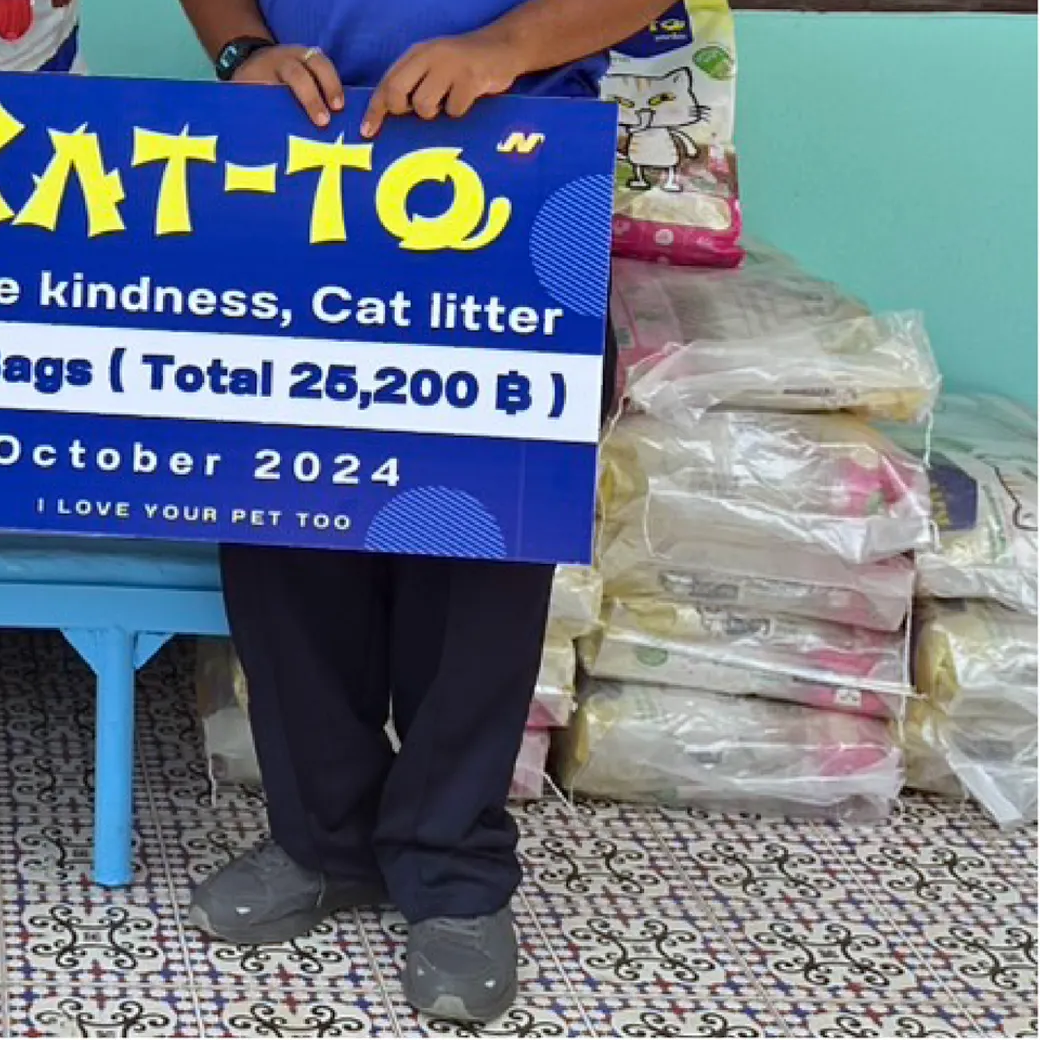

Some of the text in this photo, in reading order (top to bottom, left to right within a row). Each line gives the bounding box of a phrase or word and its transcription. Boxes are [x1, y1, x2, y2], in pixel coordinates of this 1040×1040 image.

[38, 271, 294, 329] kindness,
[311, 285, 412, 328] Cat
[429, 292, 565, 336] litter
[141, 353, 274, 398] Total
[288, 362, 481, 411] 25,200
[252, 448, 401, 488] 2024
[36, 497, 353, 532] I LOVE YOUR PET TOO
